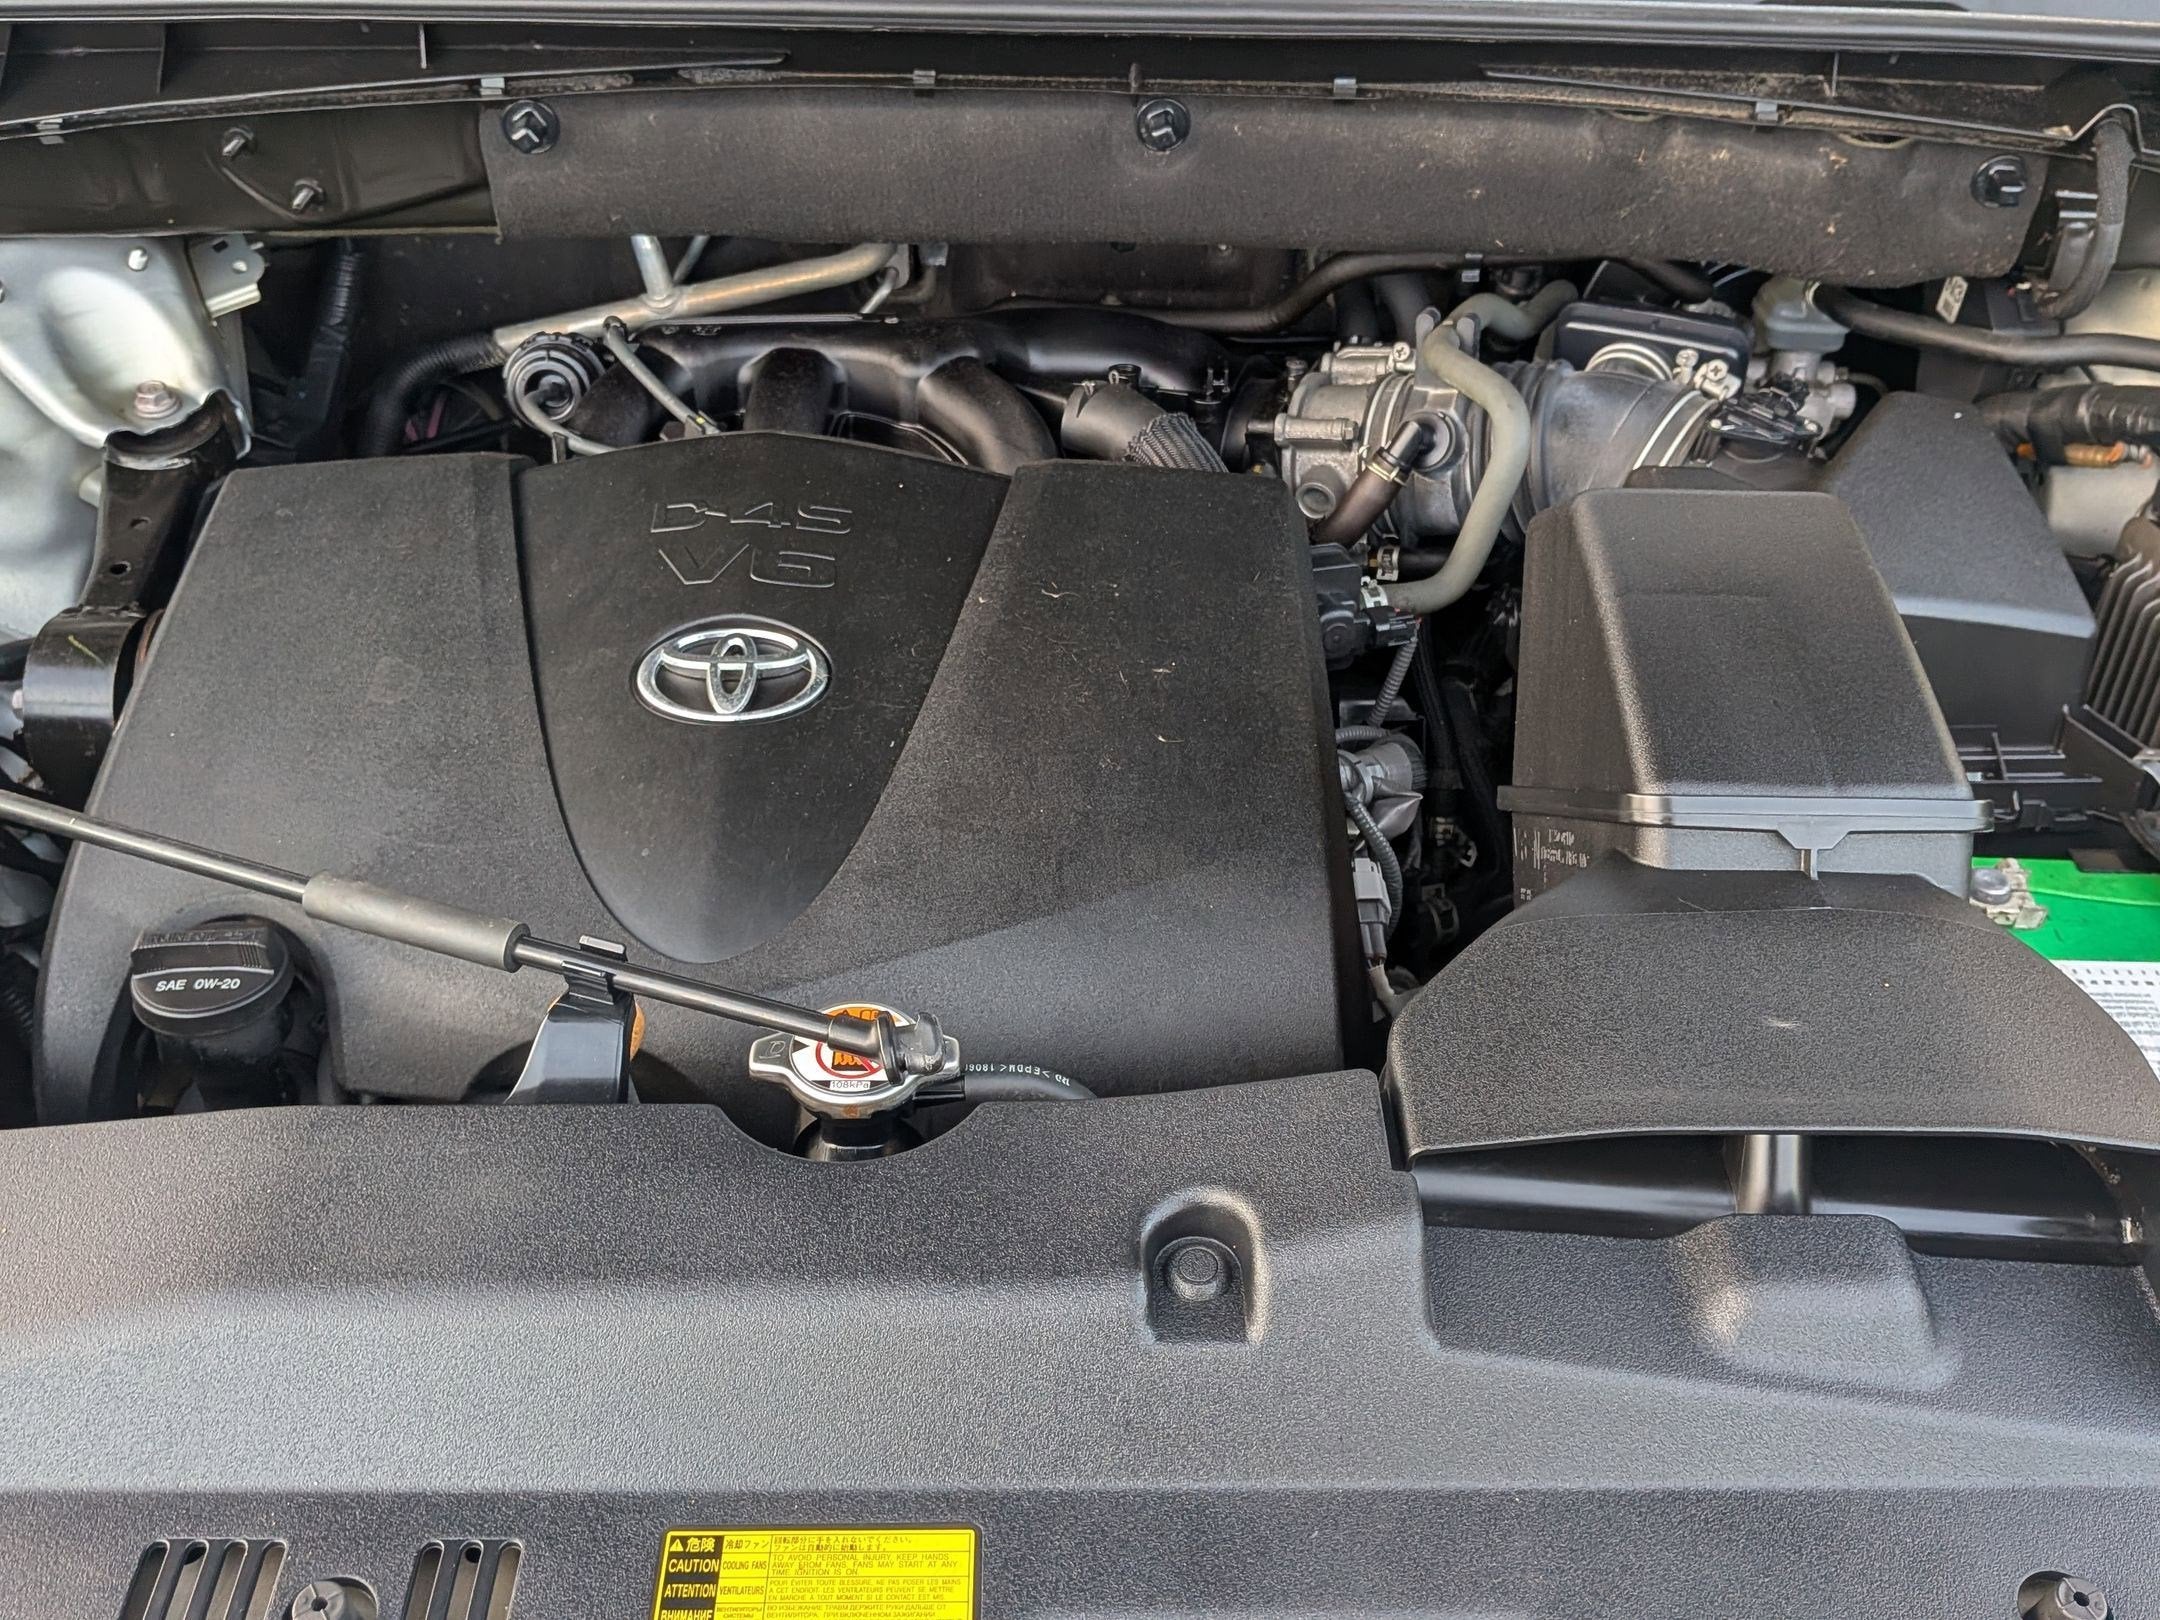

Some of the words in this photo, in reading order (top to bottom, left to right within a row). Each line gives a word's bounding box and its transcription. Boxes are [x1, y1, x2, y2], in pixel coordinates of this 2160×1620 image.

[658, 543, 837, 589] V6
[155, 979, 187, 992] SAE
[193, 977, 241, 990] 0W-20
[686, 1537, 715, 1552] 危険
[725, 1539, 769, 1549] 冷却ファン
[773, 1553, 784, 1561] TO
[788, 1553, 812, 1561] AVOID
[816, 1553, 858, 1561] PERSONAL
[896, 1553, 918, 1561] KEEP
[922, 1553, 949, 1561] HANDS
[668, 1559, 720, 1573] CAUTION
[722, 1560, 749, 1570] COOLING
[751, 1560, 767, 1570] FANS
[772, 1561, 794, 1569] AWAY
[853, 1561, 873, 1569] FANS
[878, 1561, 894, 1569] MAY
[899, 1561, 924, 1569] START
[928, 1561, 937, 1569] AT
[941, 1561, 958, 1569] ANY
[664, 1583, 716, 1598] ATTENTION
[719, 1586, 765, 1596] VENTILATEURS
